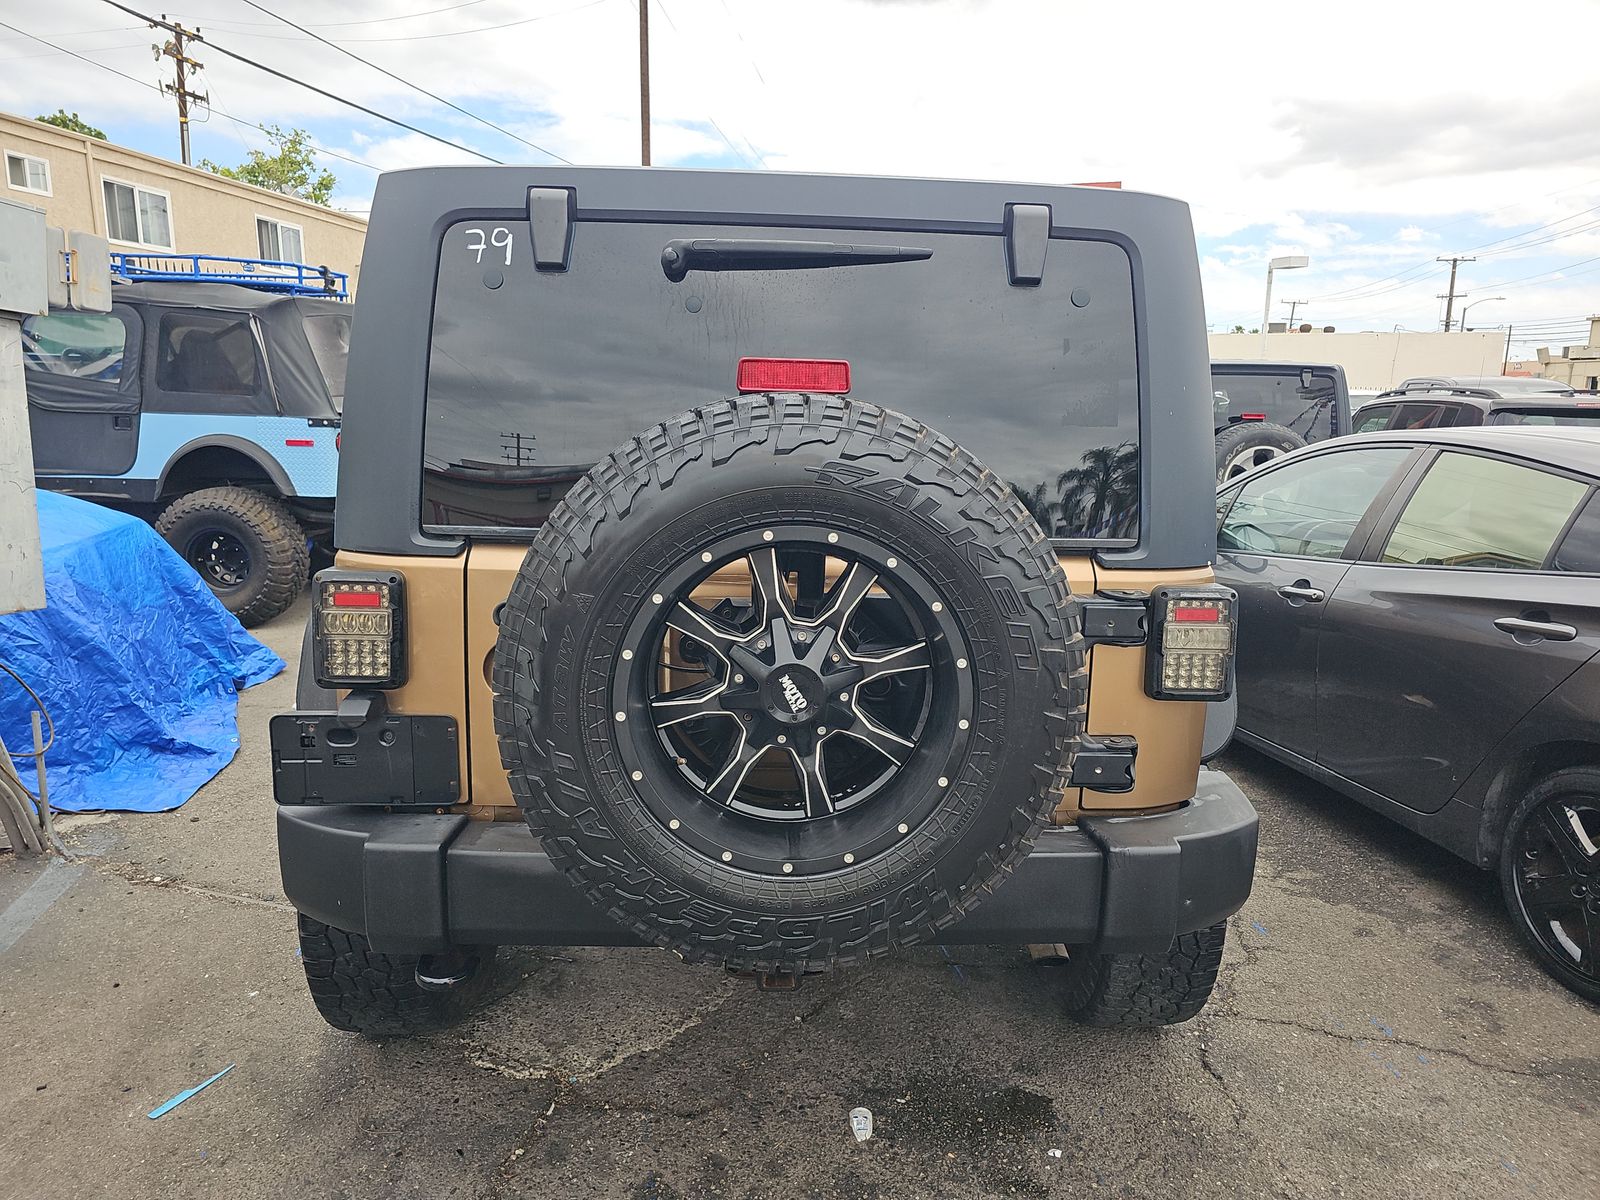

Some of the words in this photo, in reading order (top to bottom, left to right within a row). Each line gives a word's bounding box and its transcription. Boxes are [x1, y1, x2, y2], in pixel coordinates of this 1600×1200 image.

[464, 228, 514, 267] 79
[804, 460, 1041, 671] FALKEN
[551, 624, 576, 735] AT3W
[778, 674, 808, 709] MOTO
[546, 739, 615, 840] A/T
[602, 850, 936, 939] WILDPEAK
[862, 849, 936, 896] LT275/70R18
